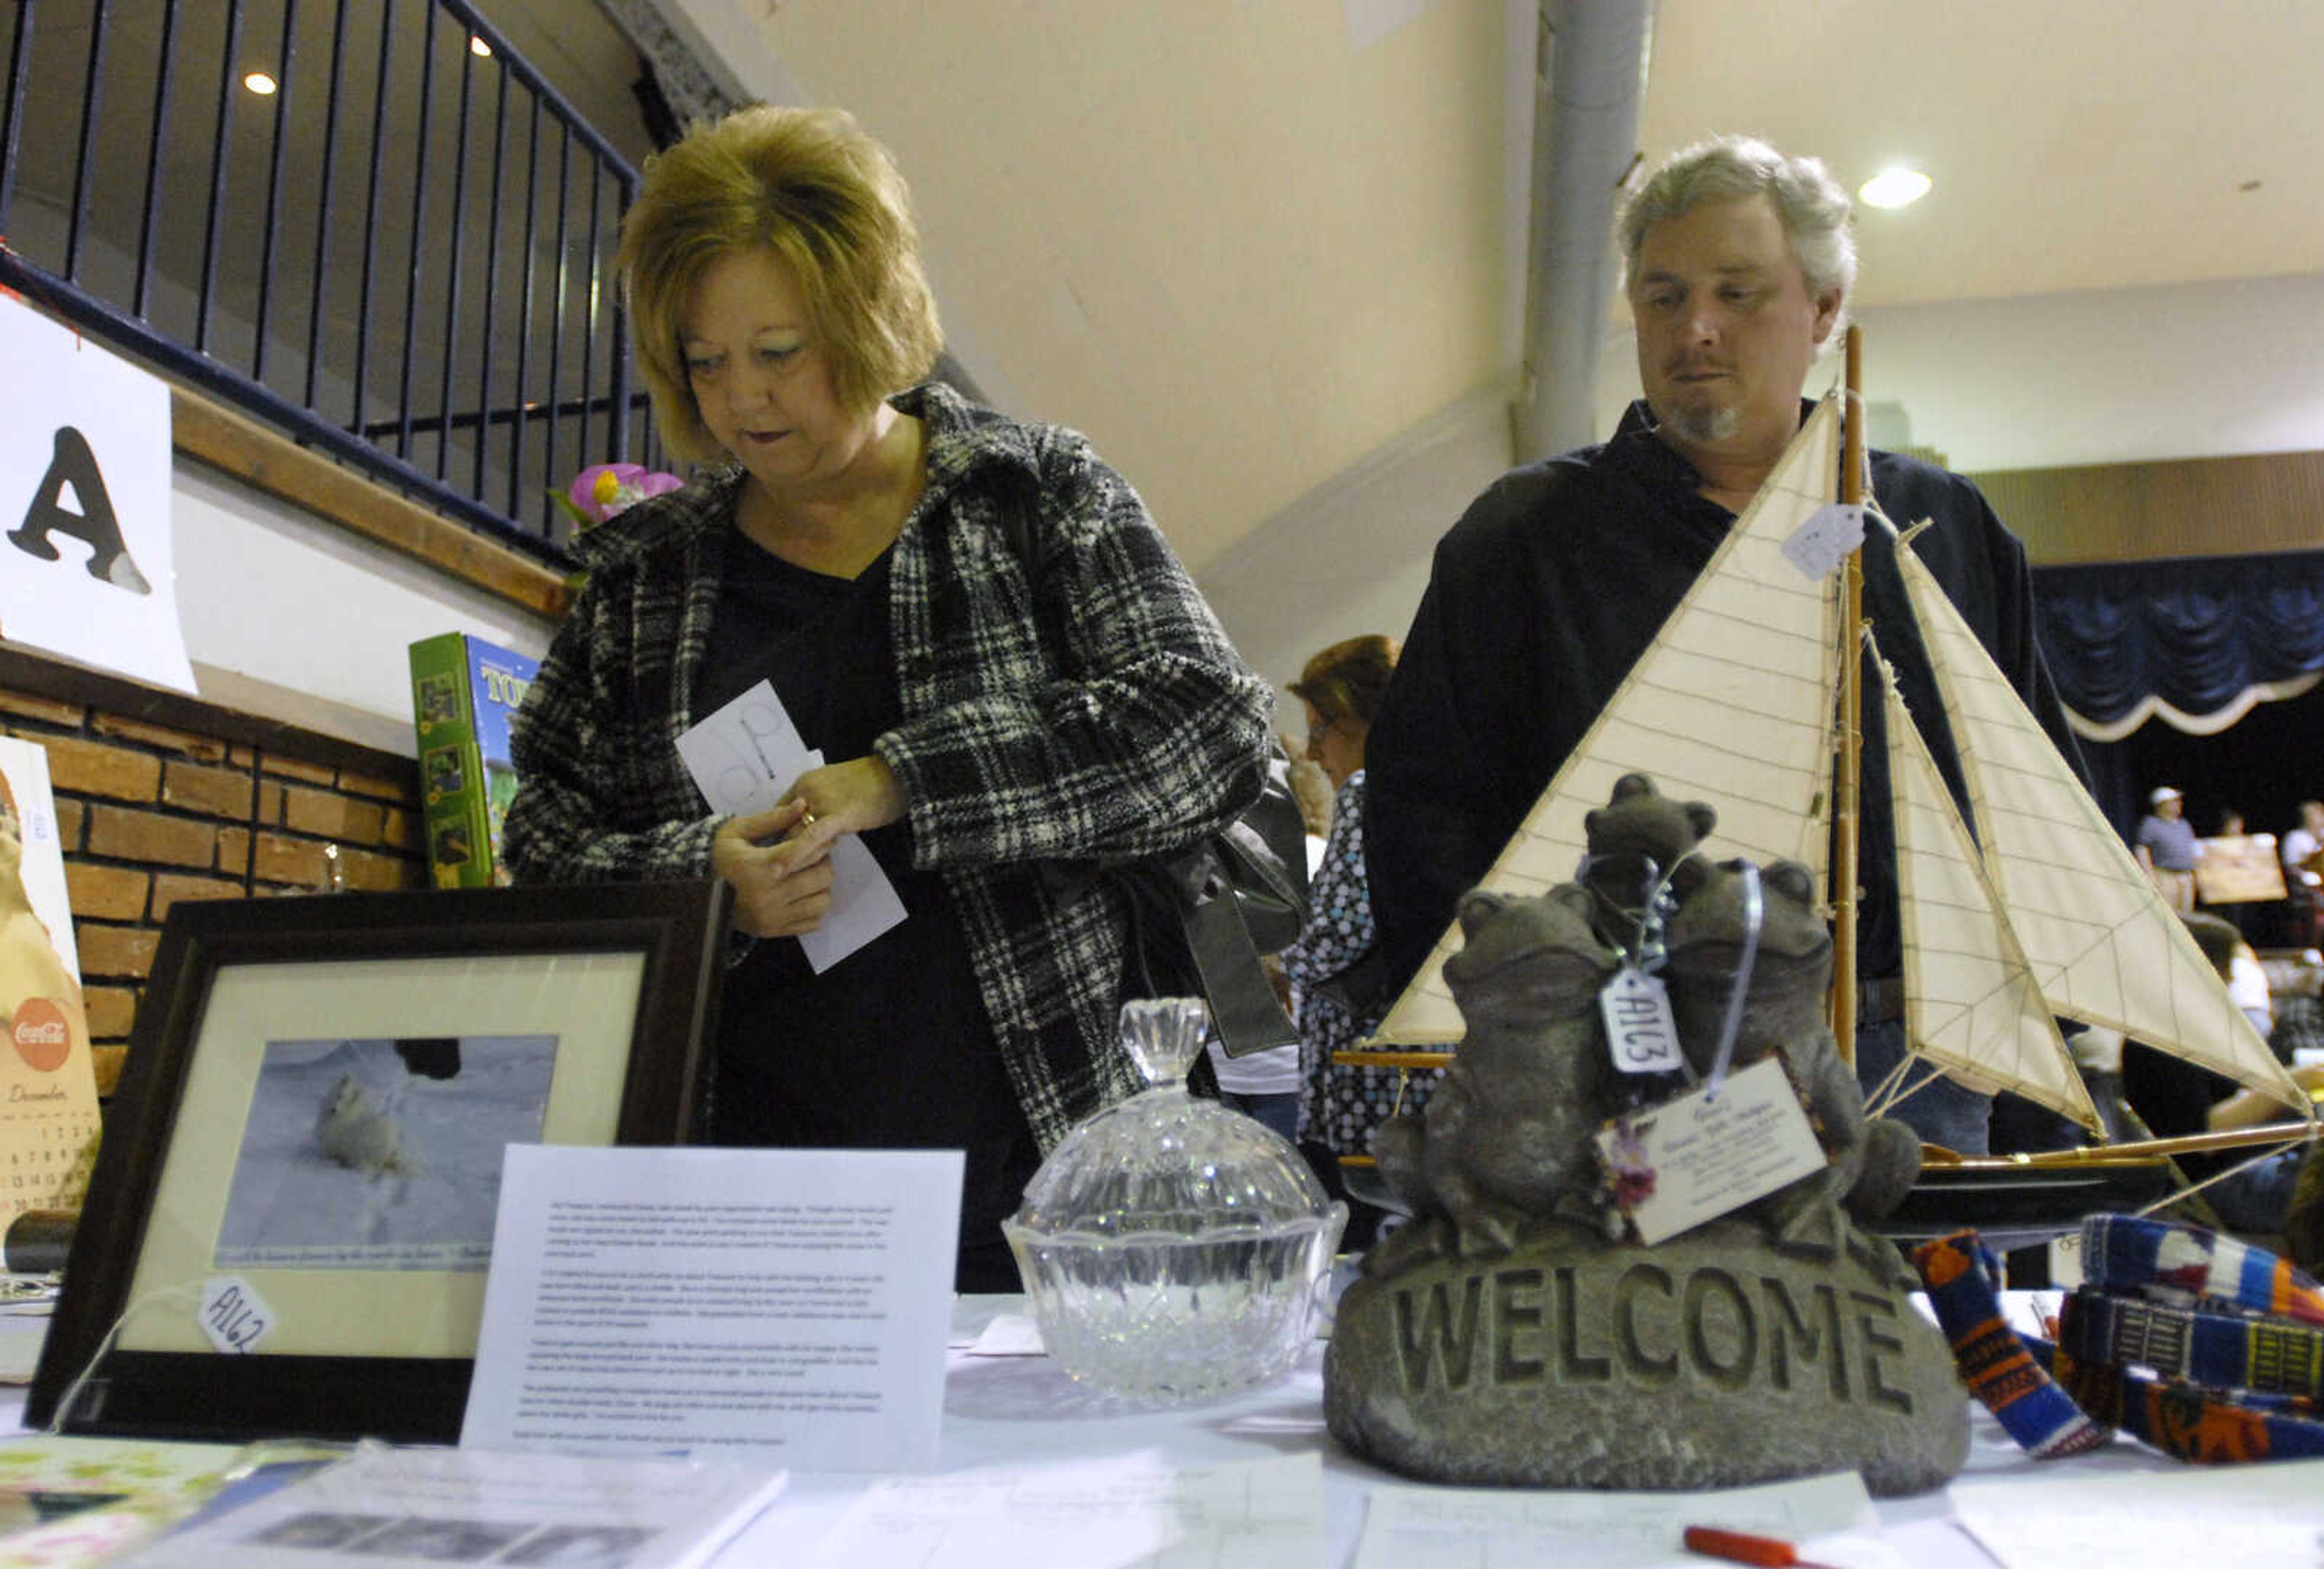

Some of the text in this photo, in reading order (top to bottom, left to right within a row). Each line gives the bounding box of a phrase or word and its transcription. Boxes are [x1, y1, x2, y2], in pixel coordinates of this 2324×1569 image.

[6, 426, 153, 596] A
[209, 1285, 264, 1355] A162
[1393, 1263, 1913, 1415] WELCOME
